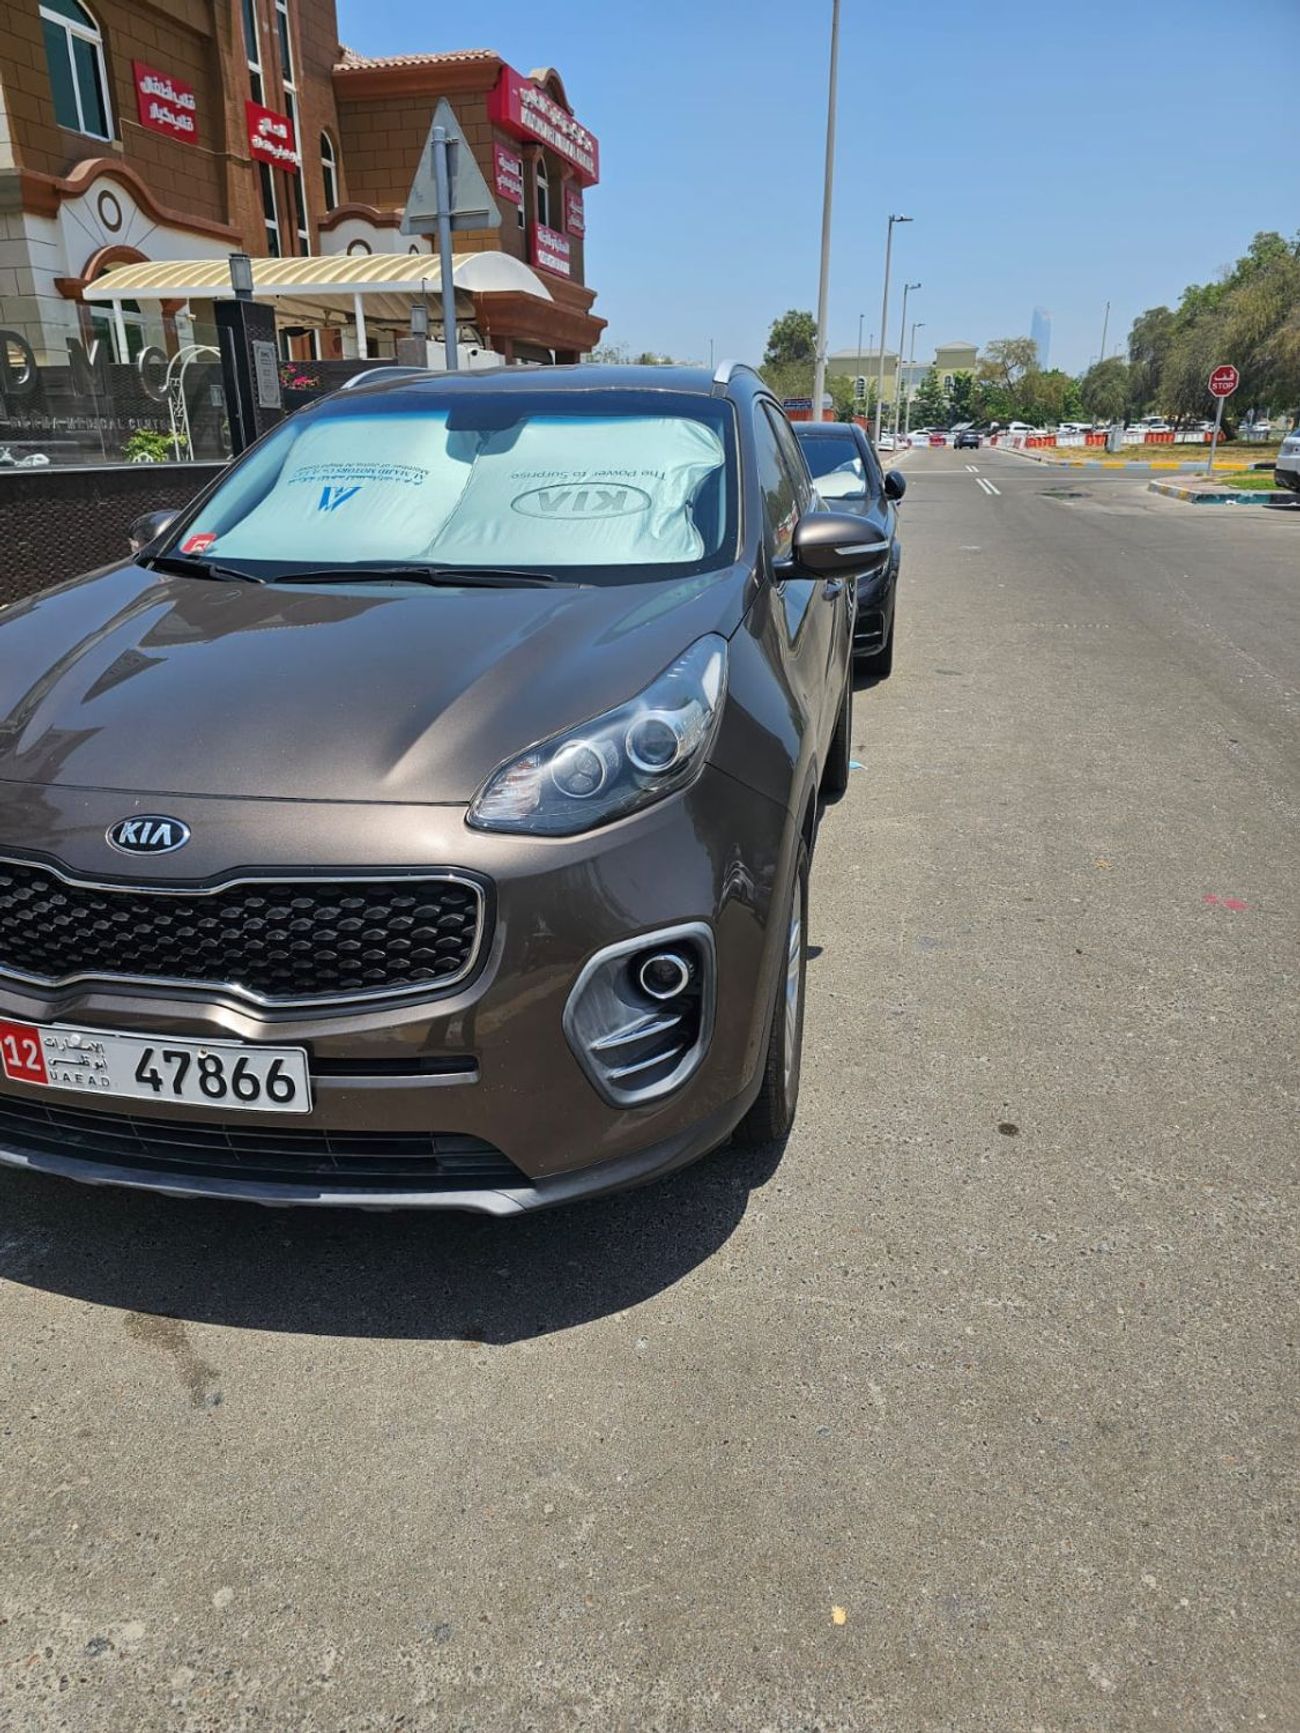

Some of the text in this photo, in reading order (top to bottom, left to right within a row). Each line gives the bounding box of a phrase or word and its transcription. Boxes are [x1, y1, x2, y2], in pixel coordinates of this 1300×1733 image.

[1213, 369, 1235, 381] قف
[1212, 382, 1234, 390] STOP
[511, 470, 568, 479] Surprise
[594, 469, 637, 478] Power
[641, 470, 667, 481] The
[538, 491, 628, 512] KIA
[118, 821, 172, 846] KIA
[3, 1034, 42, 1072] 12
[134, 1047, 297, 1104] 47866
